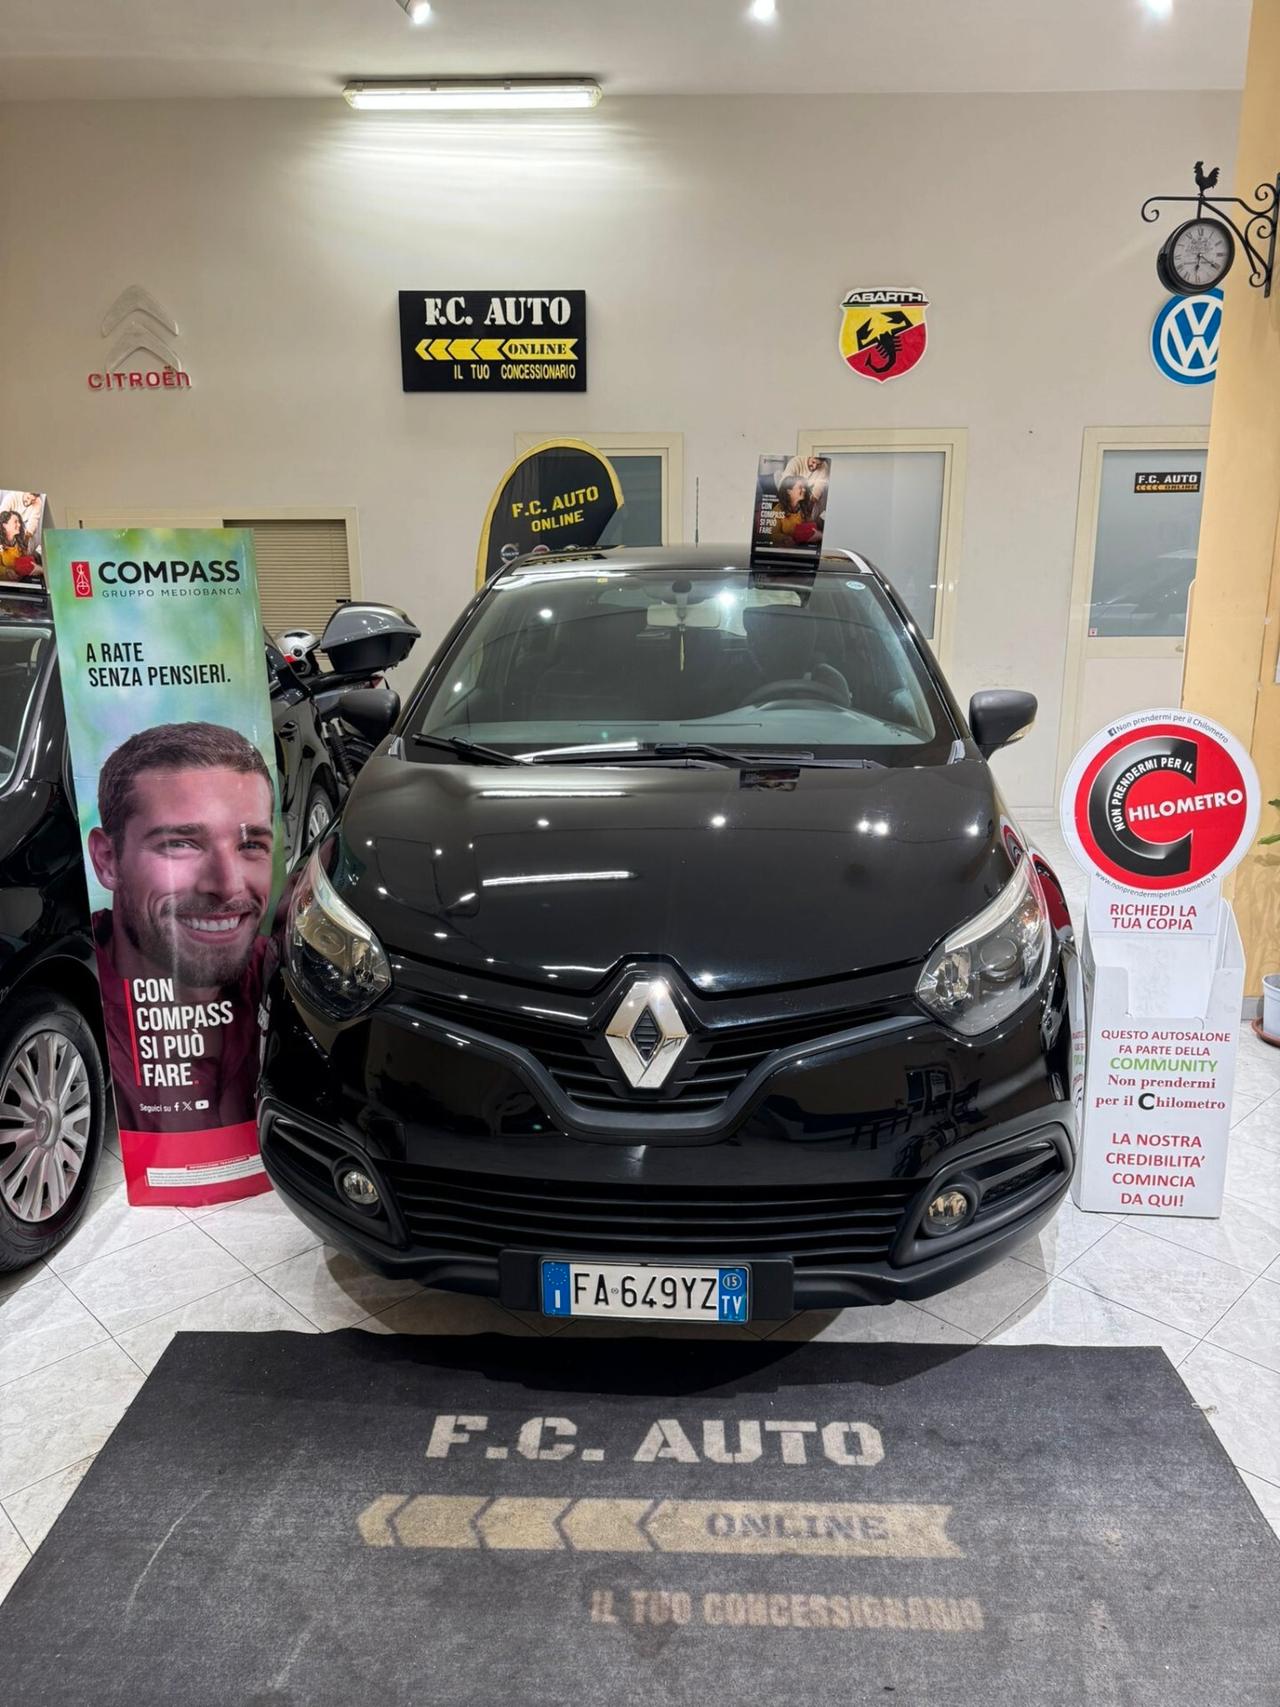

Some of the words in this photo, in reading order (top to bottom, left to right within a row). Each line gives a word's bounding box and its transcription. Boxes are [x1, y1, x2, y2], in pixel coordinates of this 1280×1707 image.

[848, 291, 922, 303] ABARTH
[424, 296, 474, 326] F.C.
[484, 296, 572, 326] AUTO
[507, 343, 568, 355] ONLINE
[453, 364, 464, 380] IL
[470, 364, 490, 380] TUO
[500, 363, 576, 380] CONCESSIONARIO
[1138, 475, 1160, 484] F.C.
[1163, 474, 1198, 484] AUTO
[511, 500, 548, 518] F.C.
[552, 485, 600, 512] AUTO
[531, 510, 585, 533] ONLINE
[97, 559, 241, 585] COMPASS
[102, 588, 155, 599] GRUPPO
[161, 587, 242, 597] MEDIOBANCA
[86, 643, 97, 663] A
[102, 642, 145, 663] RATE
[88, 667, 143, 688] SENZA
[148, 664, 231, 686] PENSIERI.
[1116, 721, 1133, 733] Non
[1132, 713, 1173, 727] prendermi
[1173, 715, 1187, 725] per
[1193, 718, 1229, 744] Chilometro
[1160, 757, 1182, 769] PER
[1183, 760, 1194, 774] IL
[1111, 758, 1158, 806] PRENDERMI
[1111, 808, 1127, 832] NON
[1109, 903, 1175, 917] RICHIEDI
[1180, 905, 1198, 918] LA
[1111, 917, 1142, 929] TUA
[1146, 918, 1193, 931] COPIA
[132, 977, 175, 1003] CON
[136, 1000, 235, 1032] COMPASS
[1101, 1029, 1149, 1040] QUESTO
[1151, 1031, 1231, 1042] AUTOSALONE
[139, 1035, 158, 1060] SI
[163, 1028, 206, 1059] PUÒ
[1119, 1045, 1133, 1054] FA
[1136, 1045, 1172, 1055] PARTE
[1175, 1046, 1211, 1056] DELLA
[1109, 1057, 1218, 1073] COMMUNITY
[1107, 1074, 1136, 1086] Non
[1139, 1077, 1216, 1090] prendermi
[139, 1102, 163, 1114] Seguici
[164, 1105, 172, 1113] su
[1095, 1096, 1120, 1108] per
[1123, 1095, 1134, 1106] il
[1137, 1092, 1226, 1111] Chilometro
[1112, 1132, 1131, 1145] LA
[1136, 1133, 1202, 1148] NOSTRA
[1111, 1172, 1196, 1188] COMINCIA
[1120, 1192, 1143, 1205] DA
[1147, 1193, 1185, 1208] QUI!
[725, 1276, 738, 1288] 15
[721, 1295, 743, 1316] TV
[425, 1414, 606, 1461] F.C.
[633, 1418, 887, 1467] AUTO
[704, 1512, 891, 1541] ONLINE
